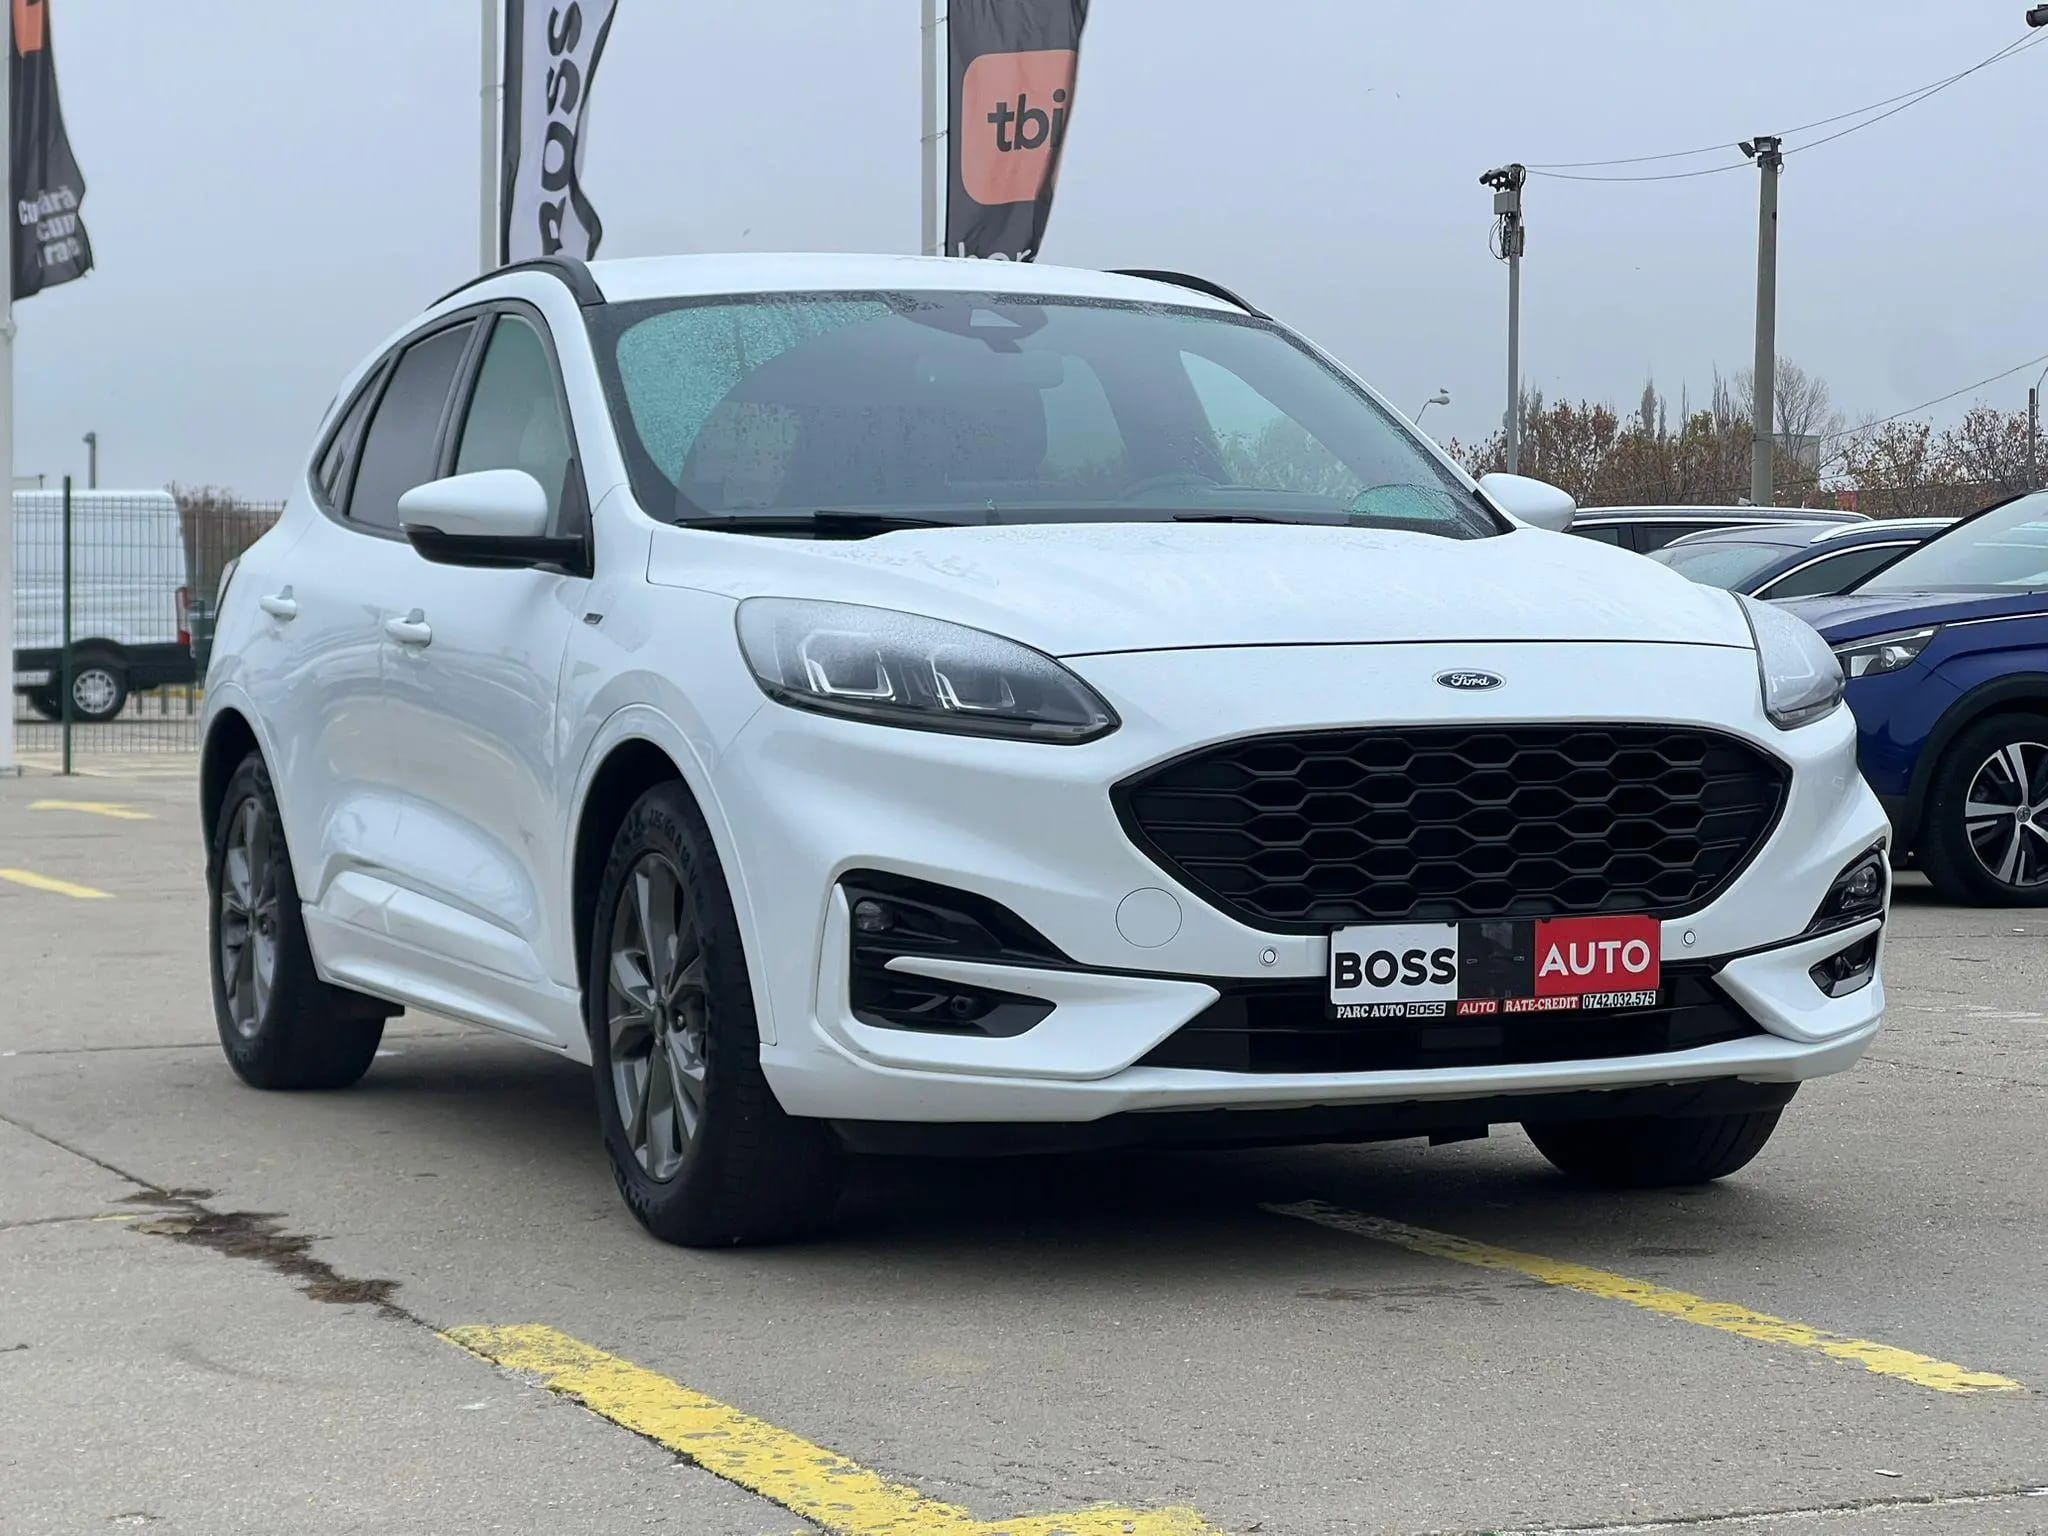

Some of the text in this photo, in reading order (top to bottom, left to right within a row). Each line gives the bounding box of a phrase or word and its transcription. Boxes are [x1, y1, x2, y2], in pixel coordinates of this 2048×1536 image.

[987, 89, 1066, 152] tbi
[1450, 673, 1490, 687] Ford
[1334, 939, 1652, 990] BOSS AUTO
[1336, 991, 1656, 1019] PARC AUTO BOSS AUTO RATE-CREDIT 0742.032.575
